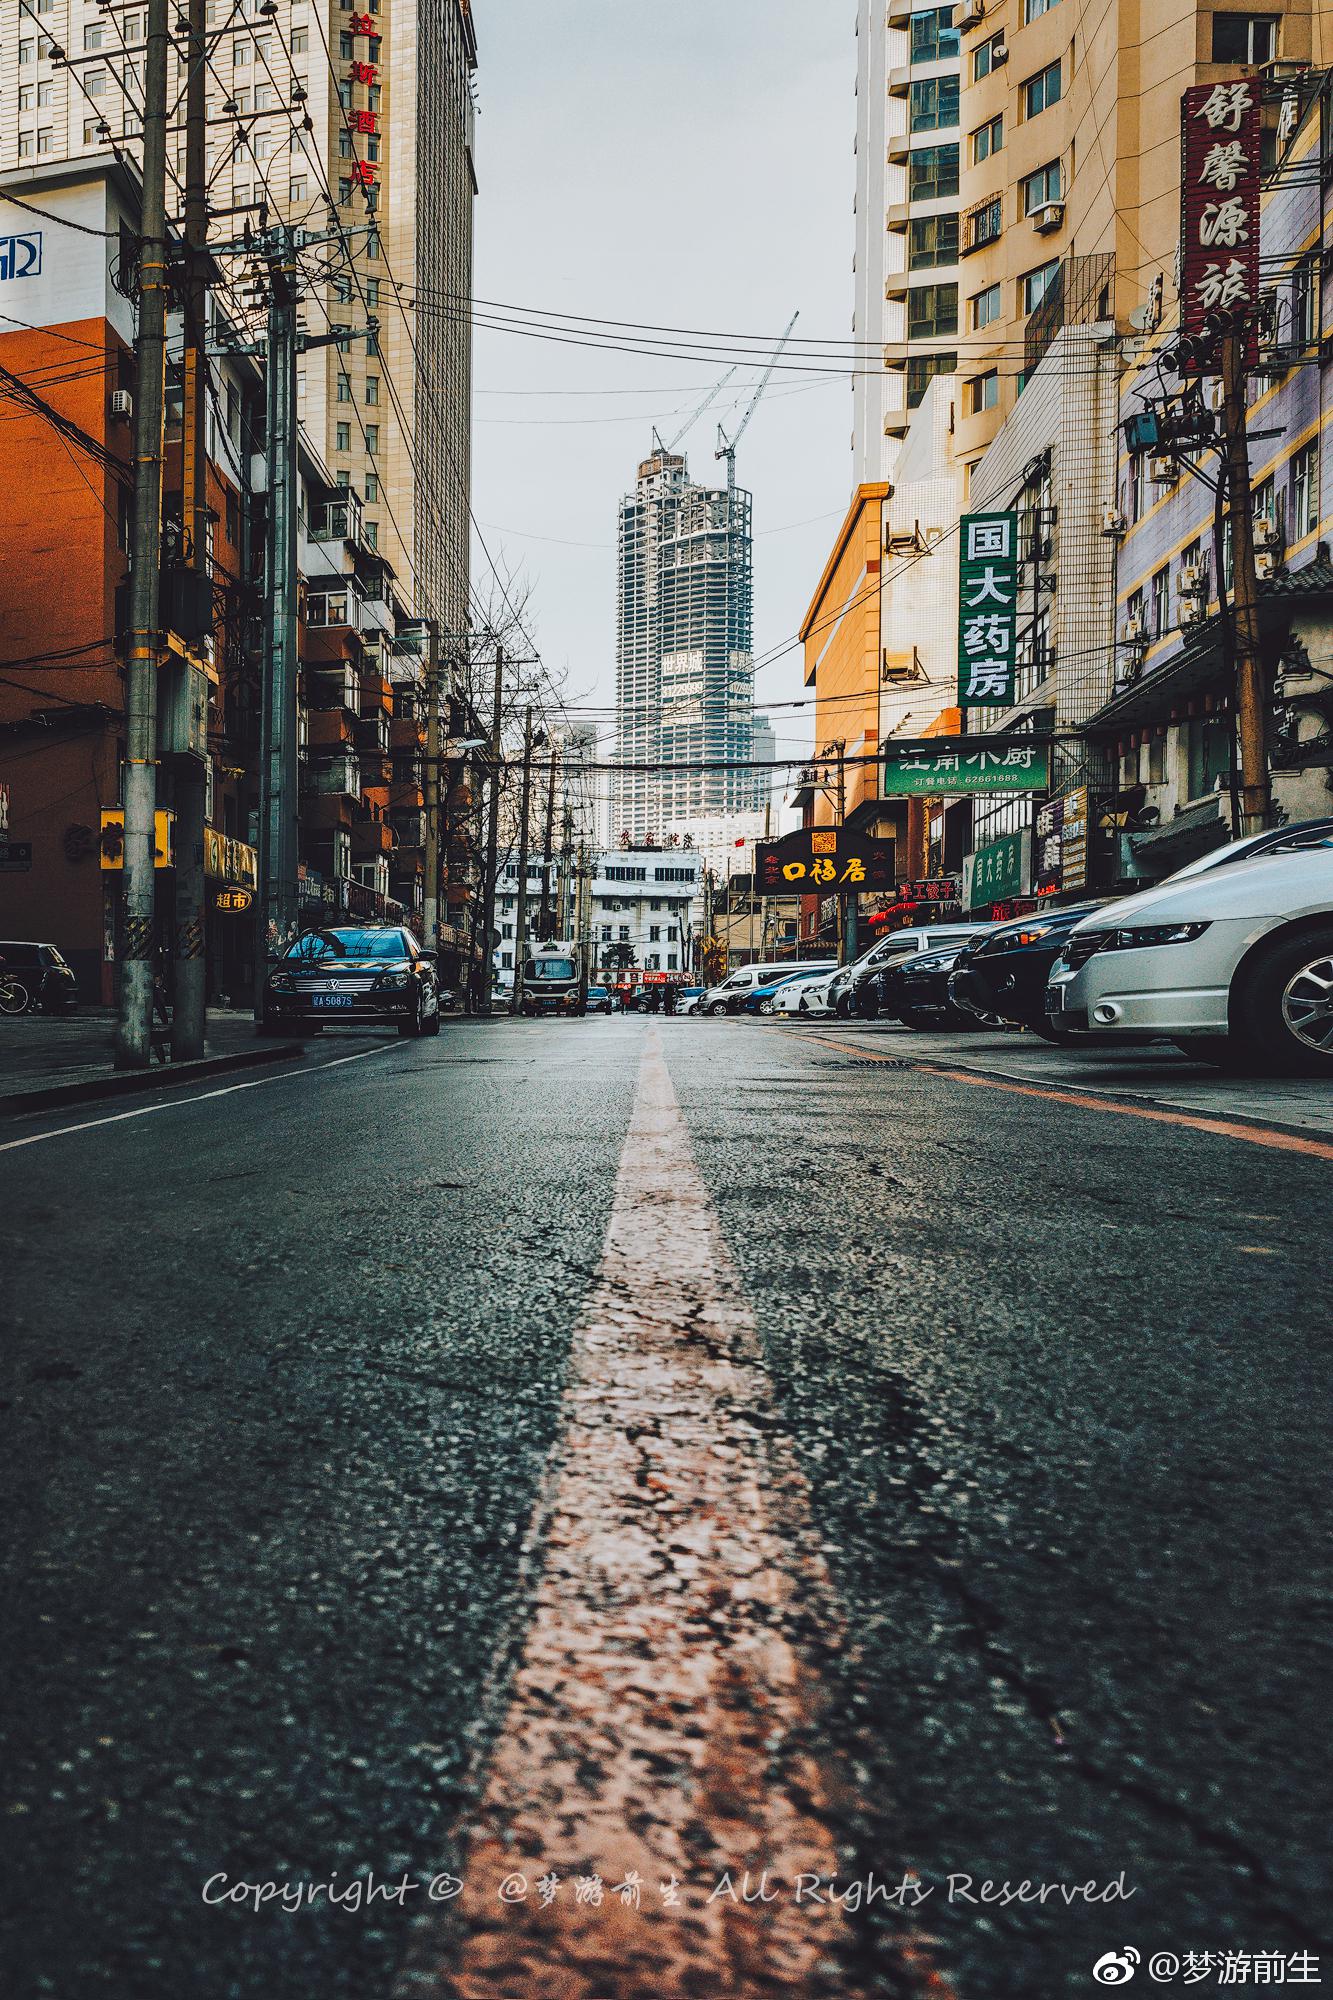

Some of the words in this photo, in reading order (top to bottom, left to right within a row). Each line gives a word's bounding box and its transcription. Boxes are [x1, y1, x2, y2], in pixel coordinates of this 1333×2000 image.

[348, 12, 379, 186] 拉斯酒店
[1194, 83, 1254, 362] 舒馨源旅
[963, 519, 1012, 697] 国大药房
[899, 745, 1037, 772] 江南小厨
[783, 858, 867, 885] 口福居
[216, 893, 247, 908] 超市
[899, 881, 954, 901] 手工饺子
